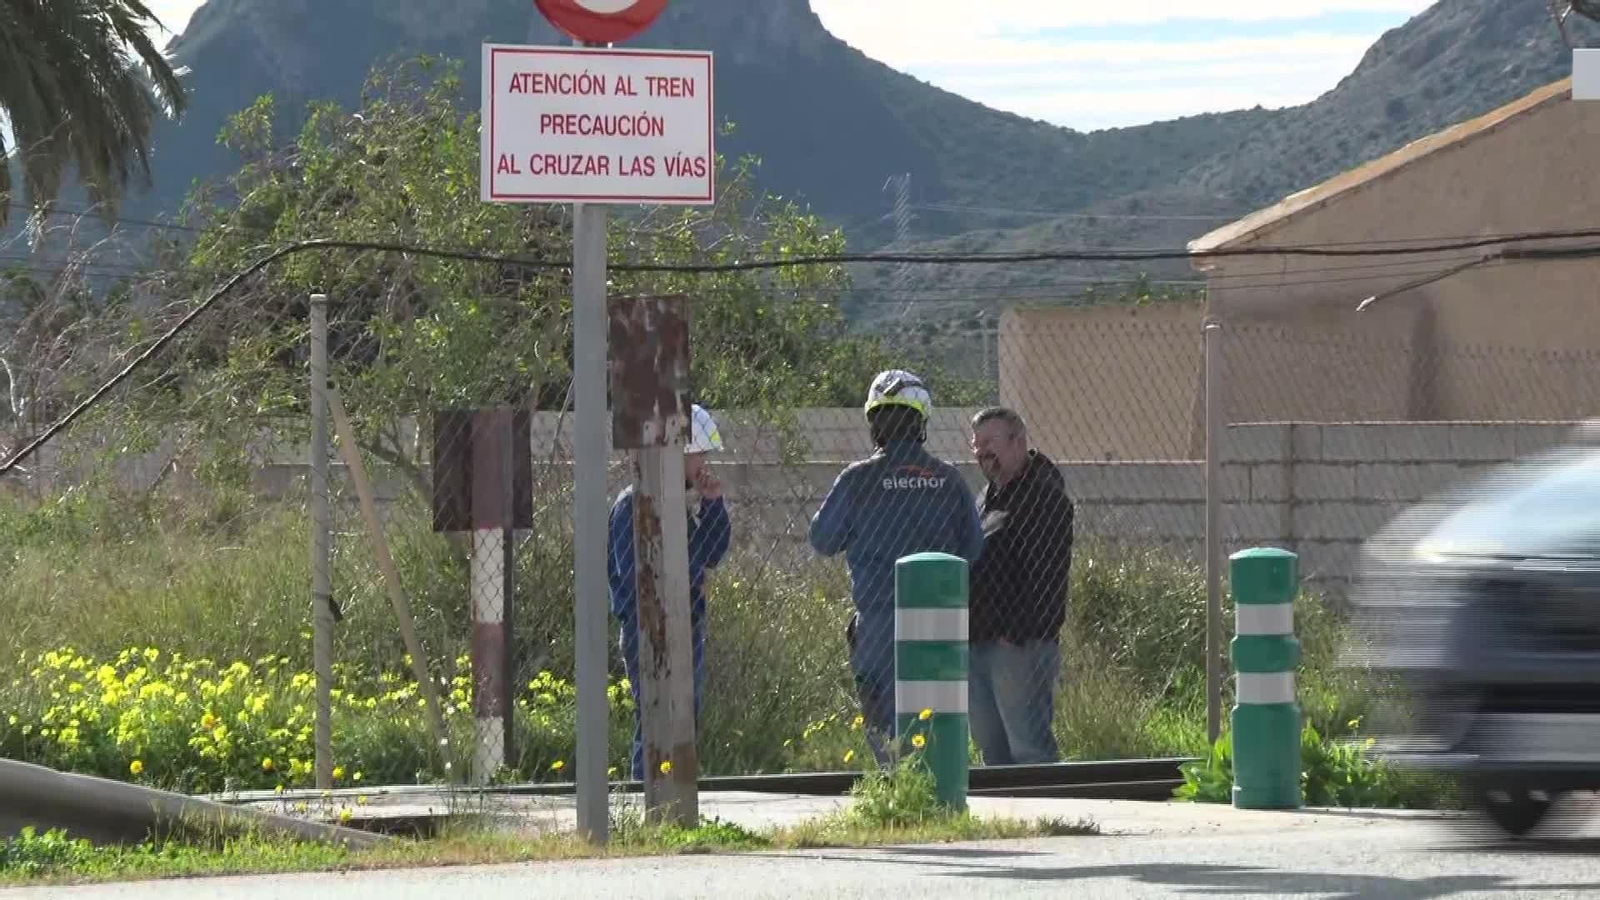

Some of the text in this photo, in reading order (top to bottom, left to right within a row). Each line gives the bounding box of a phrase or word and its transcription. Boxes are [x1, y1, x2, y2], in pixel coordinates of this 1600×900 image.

[509, 68, 694, 97] ATENCIÓN AL TREN
[540, 111, 664, 136] PRECAUCIÓN
[497, 151, 706, 178] AL CRUZAR LAS VÍAS
[882, 475, 946, 490] elecnor
